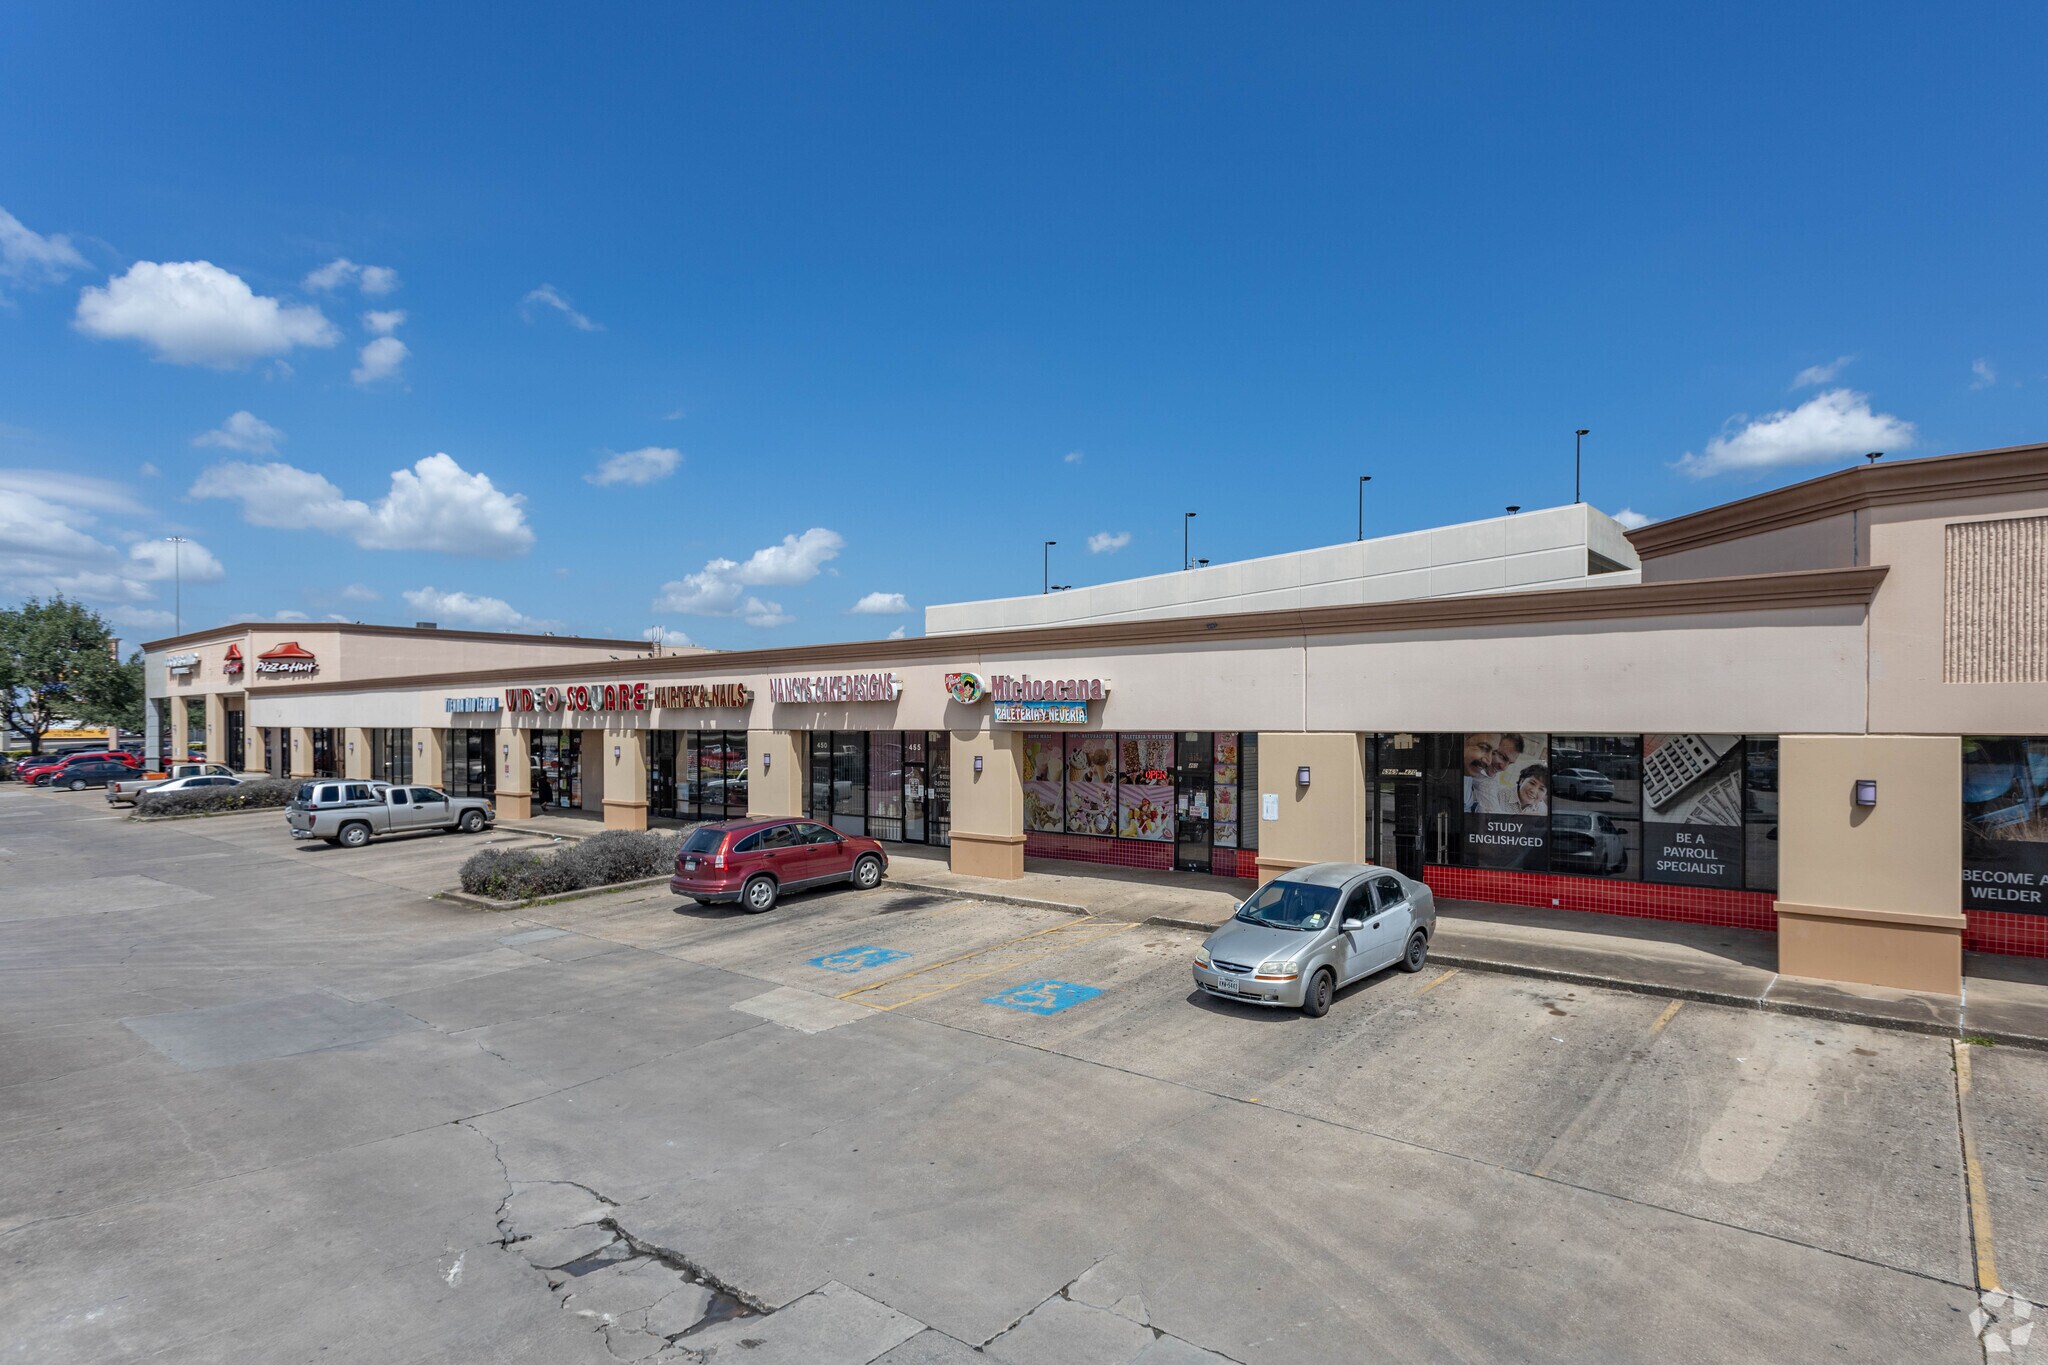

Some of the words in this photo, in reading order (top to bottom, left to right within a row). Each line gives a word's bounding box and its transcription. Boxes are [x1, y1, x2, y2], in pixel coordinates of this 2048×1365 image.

[254, 662, 288, 673] Pizza
[288, 662, 316, 673] Hut
[769, 677, 813, 703] NANCY'S
[815, 676, 843, 702] CAKE
[845, 673, 894, 702] DESIGNS
[991, 674, 1104, 700] Michoacana
[505, 687, 558, 712] VIDEO
[567, 683, 648, 711] SQUARE
[712, 682, 746, 707] NAILS
[996, 708, 1040, 720] PALETERIA
[1041, 708, 1047, 720] Y
[908, 743, 921, 751] 455
[1145, 769, 1166, 780] OPEN
[1487, 821, 1523, 833] STUDY
[1468, 834, 1543, 847] ENGLISH/GED
[1676, 833, 1692, 844] BE
[1695, 833, 1705, 844] A
[1663, 846, 1718, 860] PAYROLL
[1656, 860, 1725, 875] SPECIALIST
[1962, 869, 2034, 885] BECOME
[2039, 874, 2048, 886] A
[1970, 886, 2042, 903] WELDER
